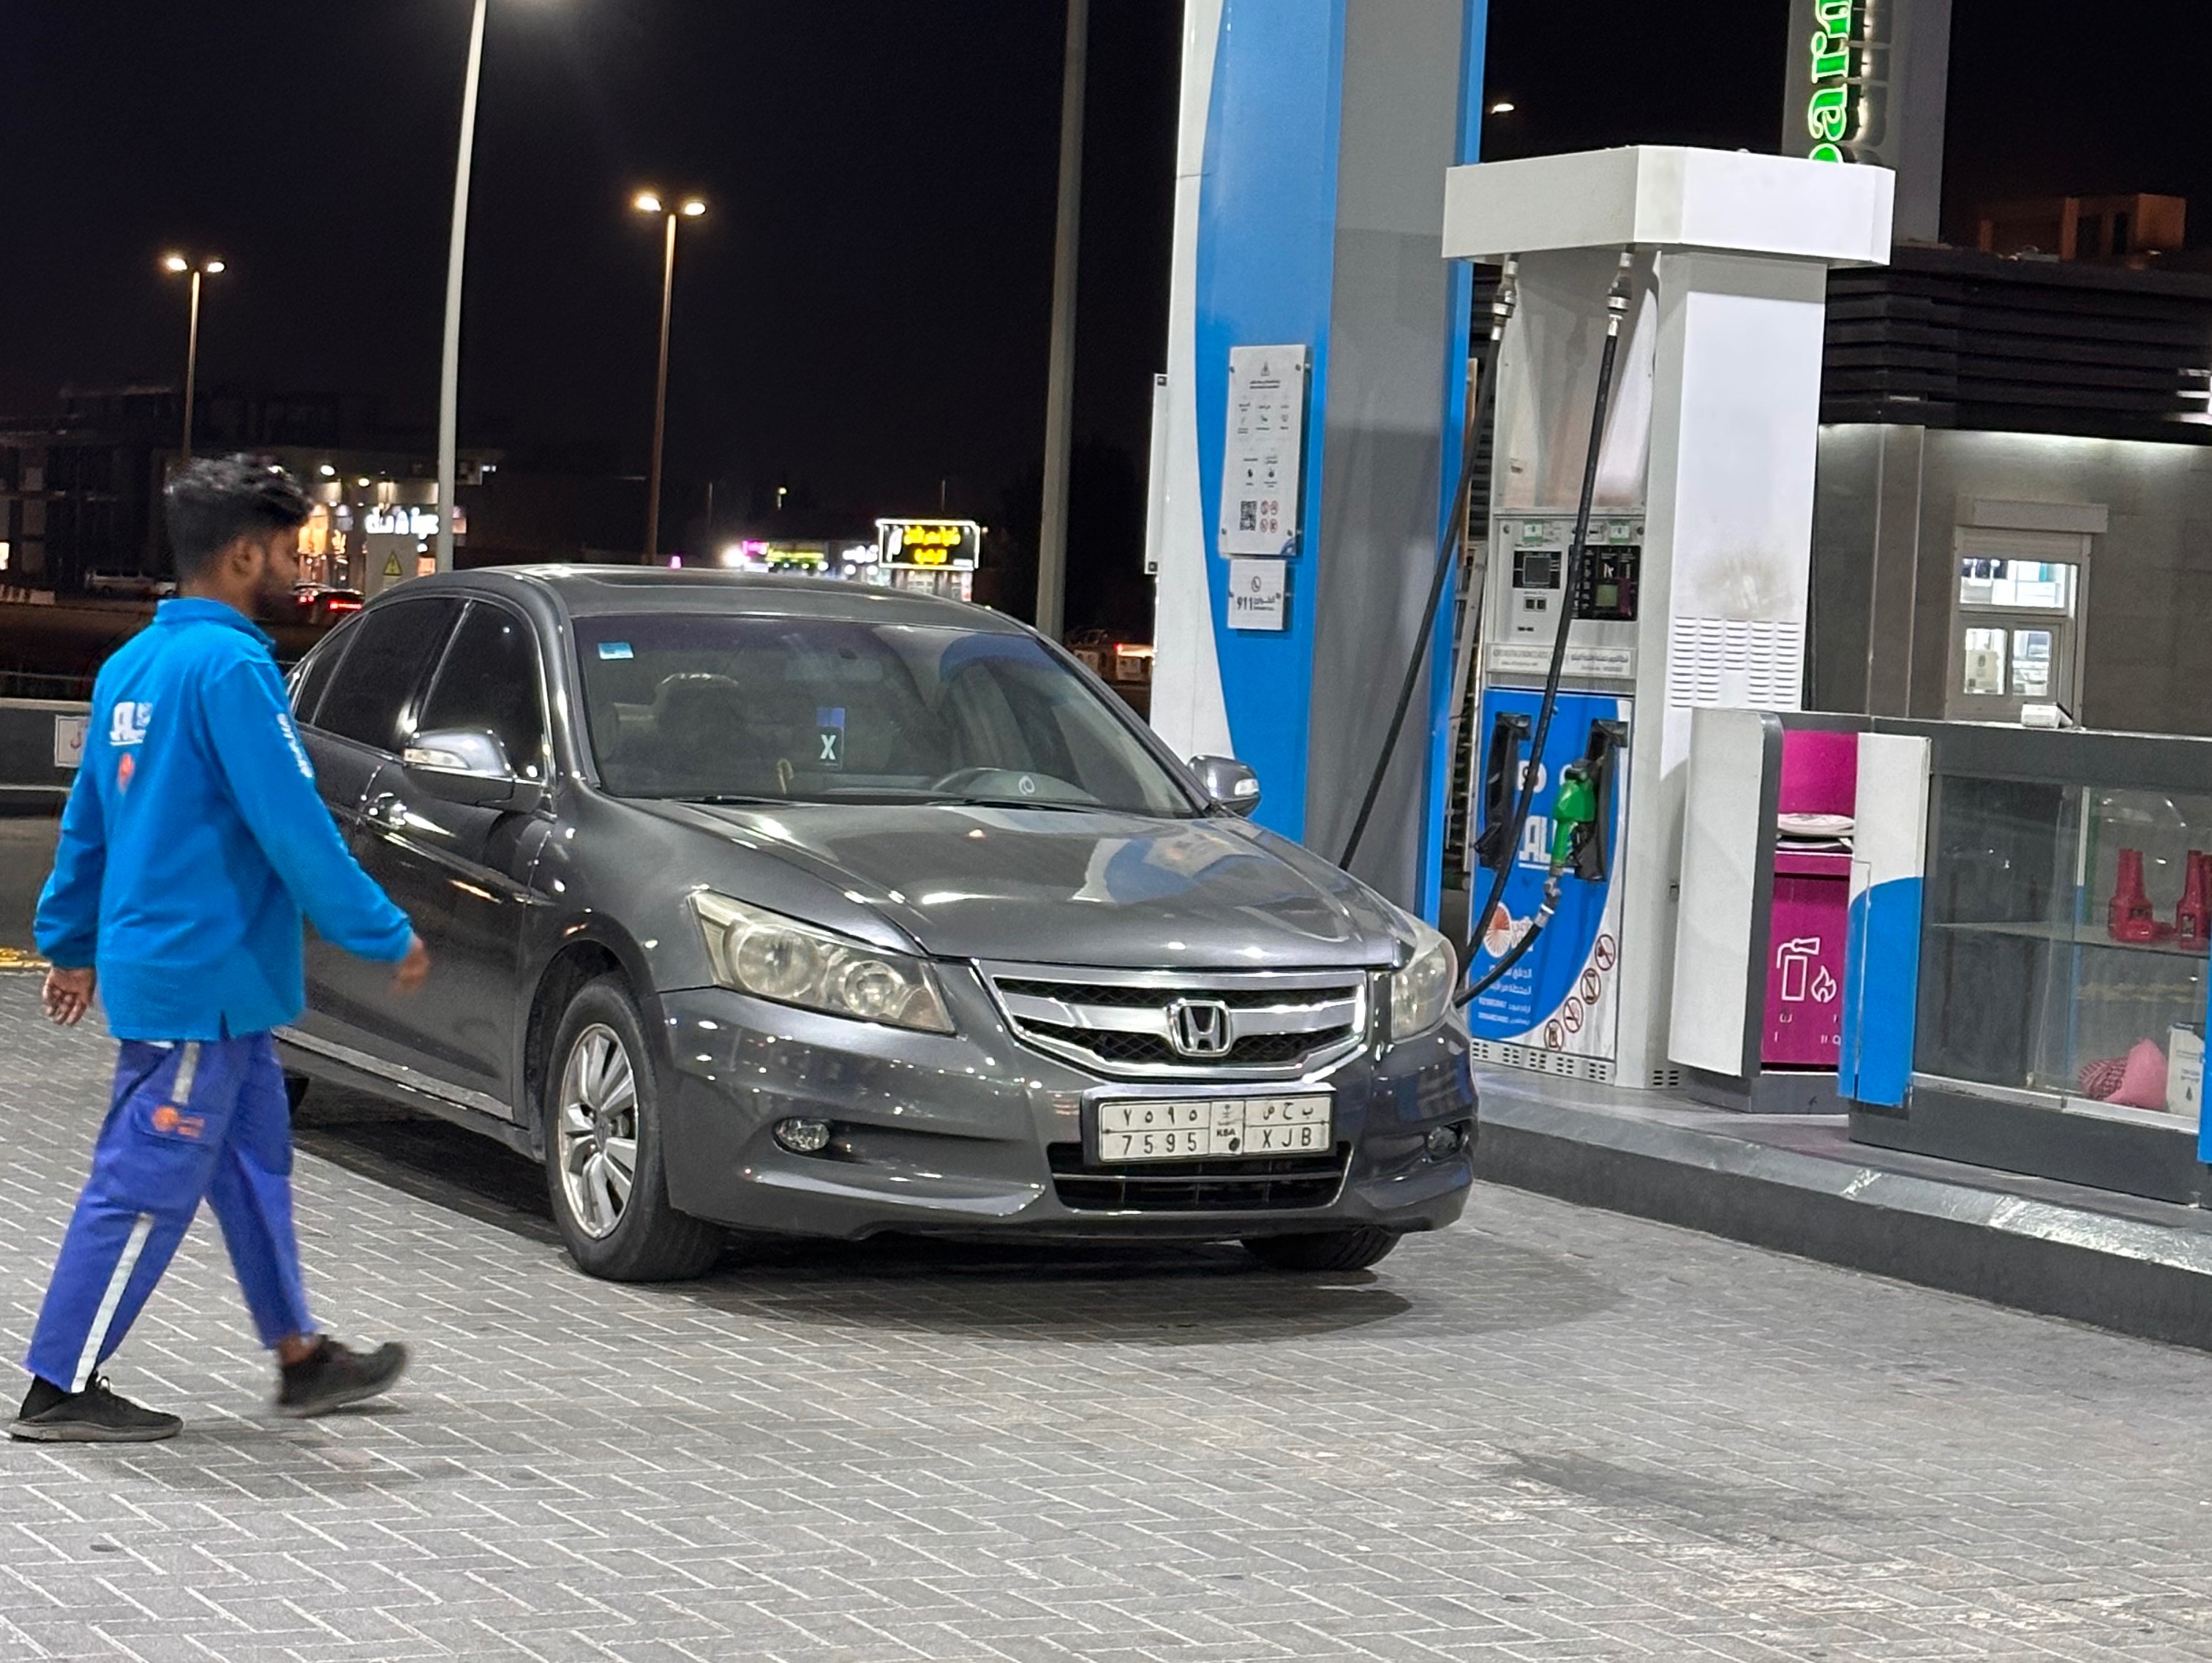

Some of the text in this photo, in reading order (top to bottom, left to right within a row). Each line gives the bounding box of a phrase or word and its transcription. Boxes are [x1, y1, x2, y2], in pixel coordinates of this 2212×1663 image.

[1237, 596, 1252, 610] 911
[820, 735, 836, 759] X
[1216, 1128, 1236, 1137] KSA
